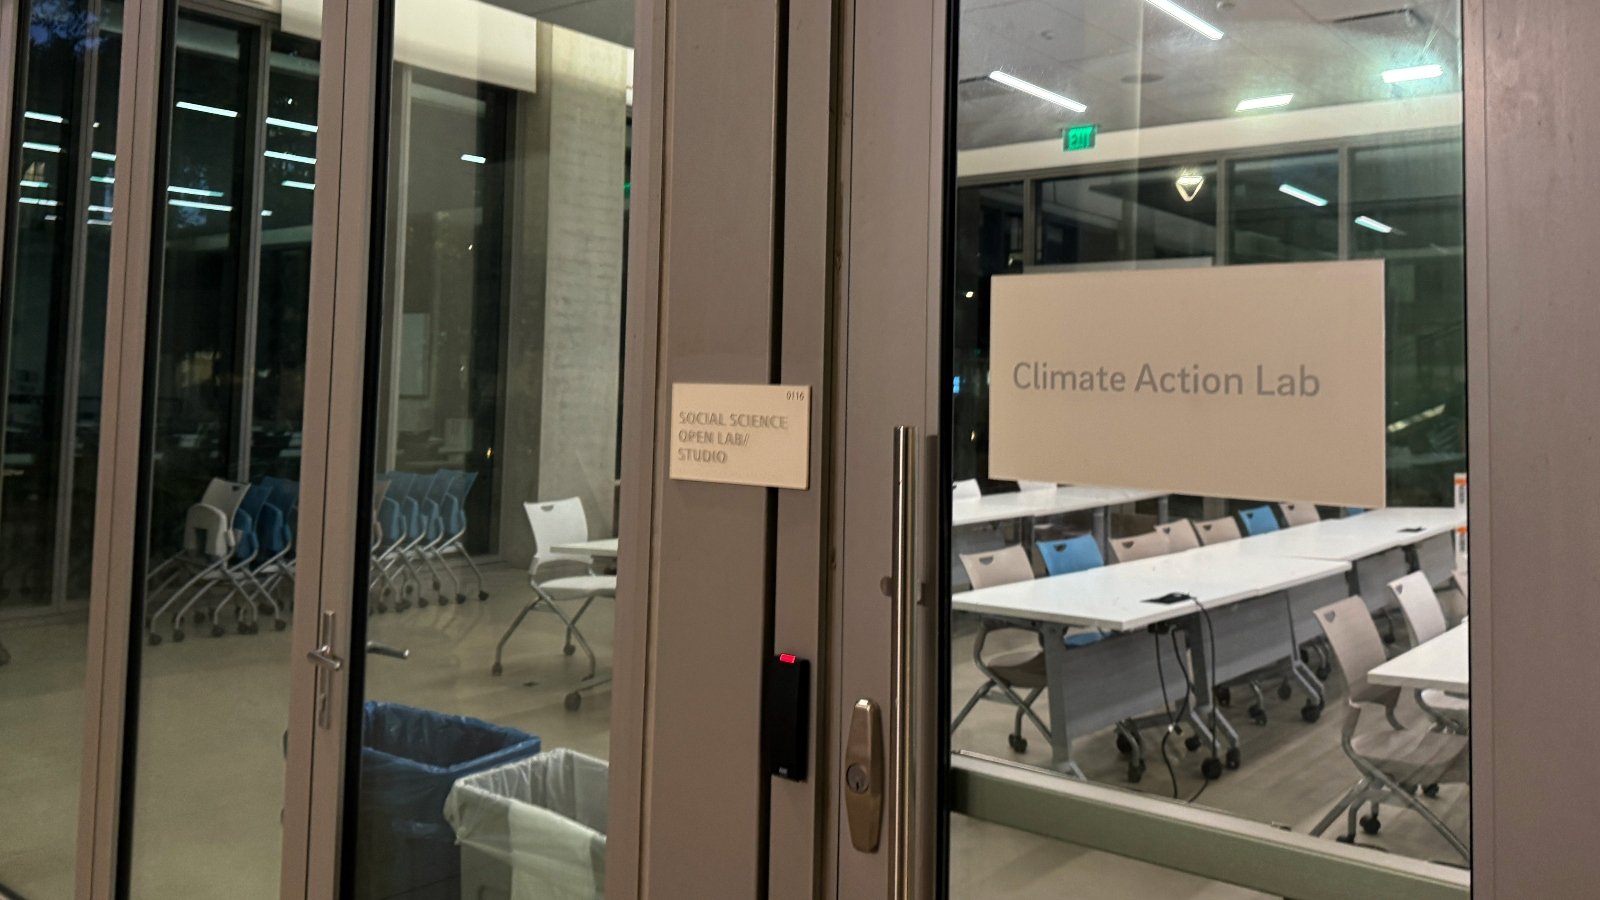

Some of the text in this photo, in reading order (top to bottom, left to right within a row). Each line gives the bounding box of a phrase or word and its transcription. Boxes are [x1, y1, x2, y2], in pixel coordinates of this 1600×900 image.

[1013, 361, 1320, 397] Climate Action Lab
[786, 391, 804, 401] 0116
[678, 411, 788, 429] SOCIAL SCIENCE
[678, 430, 749, 447] OPEN LAB/
[678, 448, 728, 464] STUDIO
